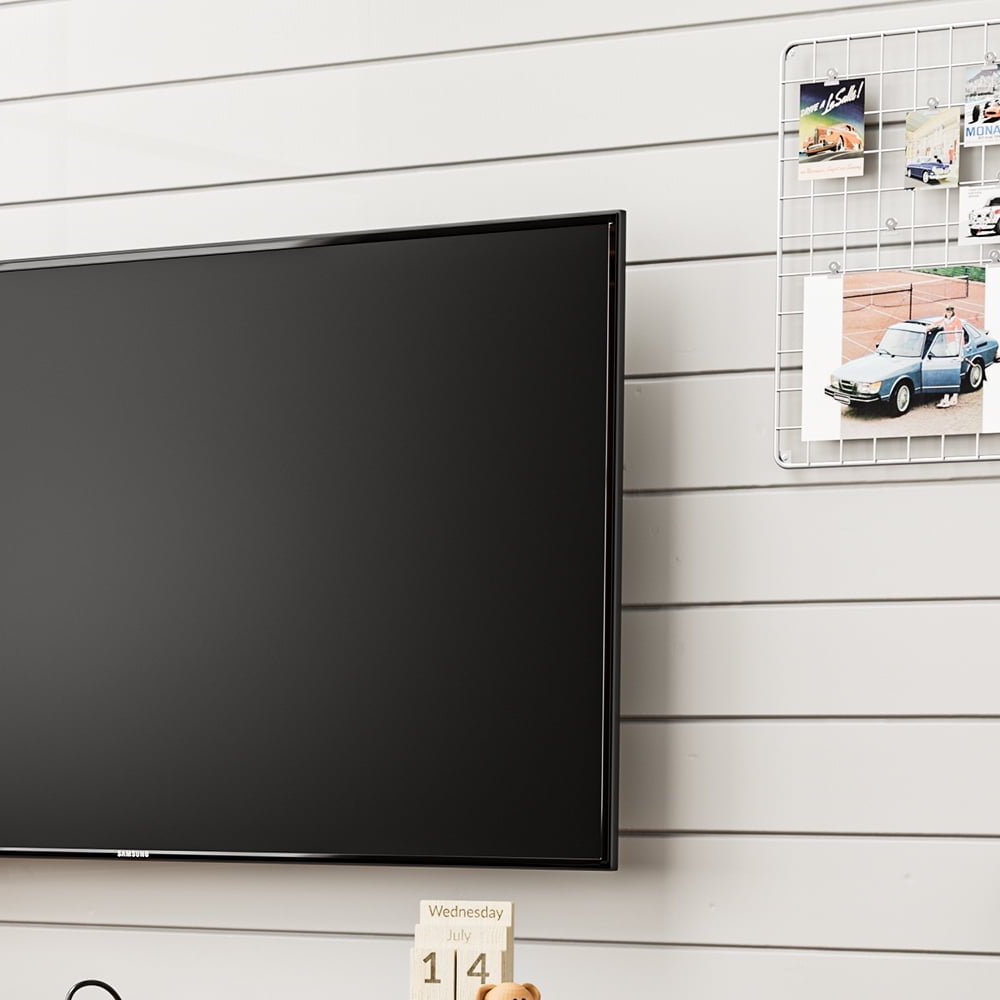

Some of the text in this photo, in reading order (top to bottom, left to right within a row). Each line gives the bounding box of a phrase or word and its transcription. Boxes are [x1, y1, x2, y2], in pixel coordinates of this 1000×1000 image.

[117, 849, 150, 858] SAMSUNG
[428, 904, 504, 921] Wednesday
[446, 929, 472, 944] July
[422, 951, 490, 984] 1 4
